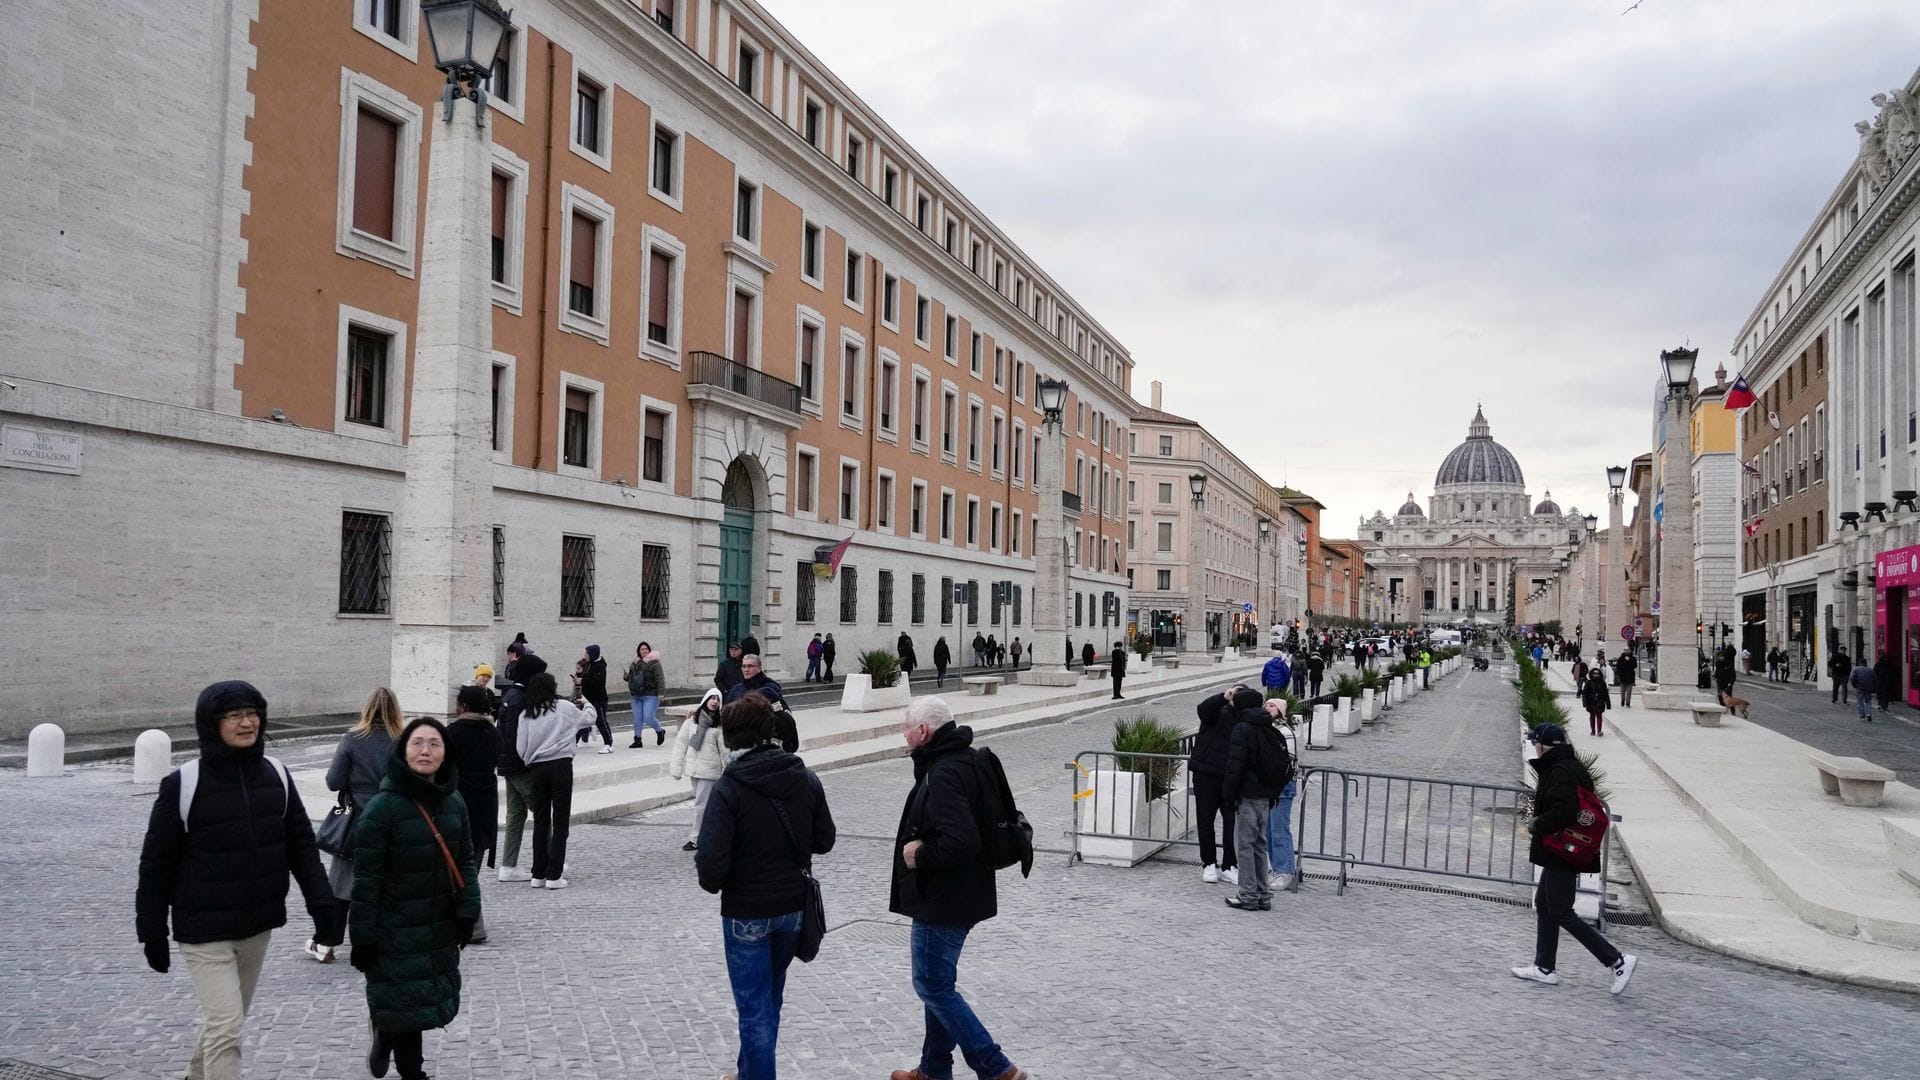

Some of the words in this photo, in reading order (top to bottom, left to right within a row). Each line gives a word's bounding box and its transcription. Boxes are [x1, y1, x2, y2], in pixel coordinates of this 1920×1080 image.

[34, 432, 50, 443] VIA
[32, 442, 53, 451] DELLA
[12, 448, 72, 462] CONCILIAZIONE
[1886, 551, 1908, 566] TOURIST
